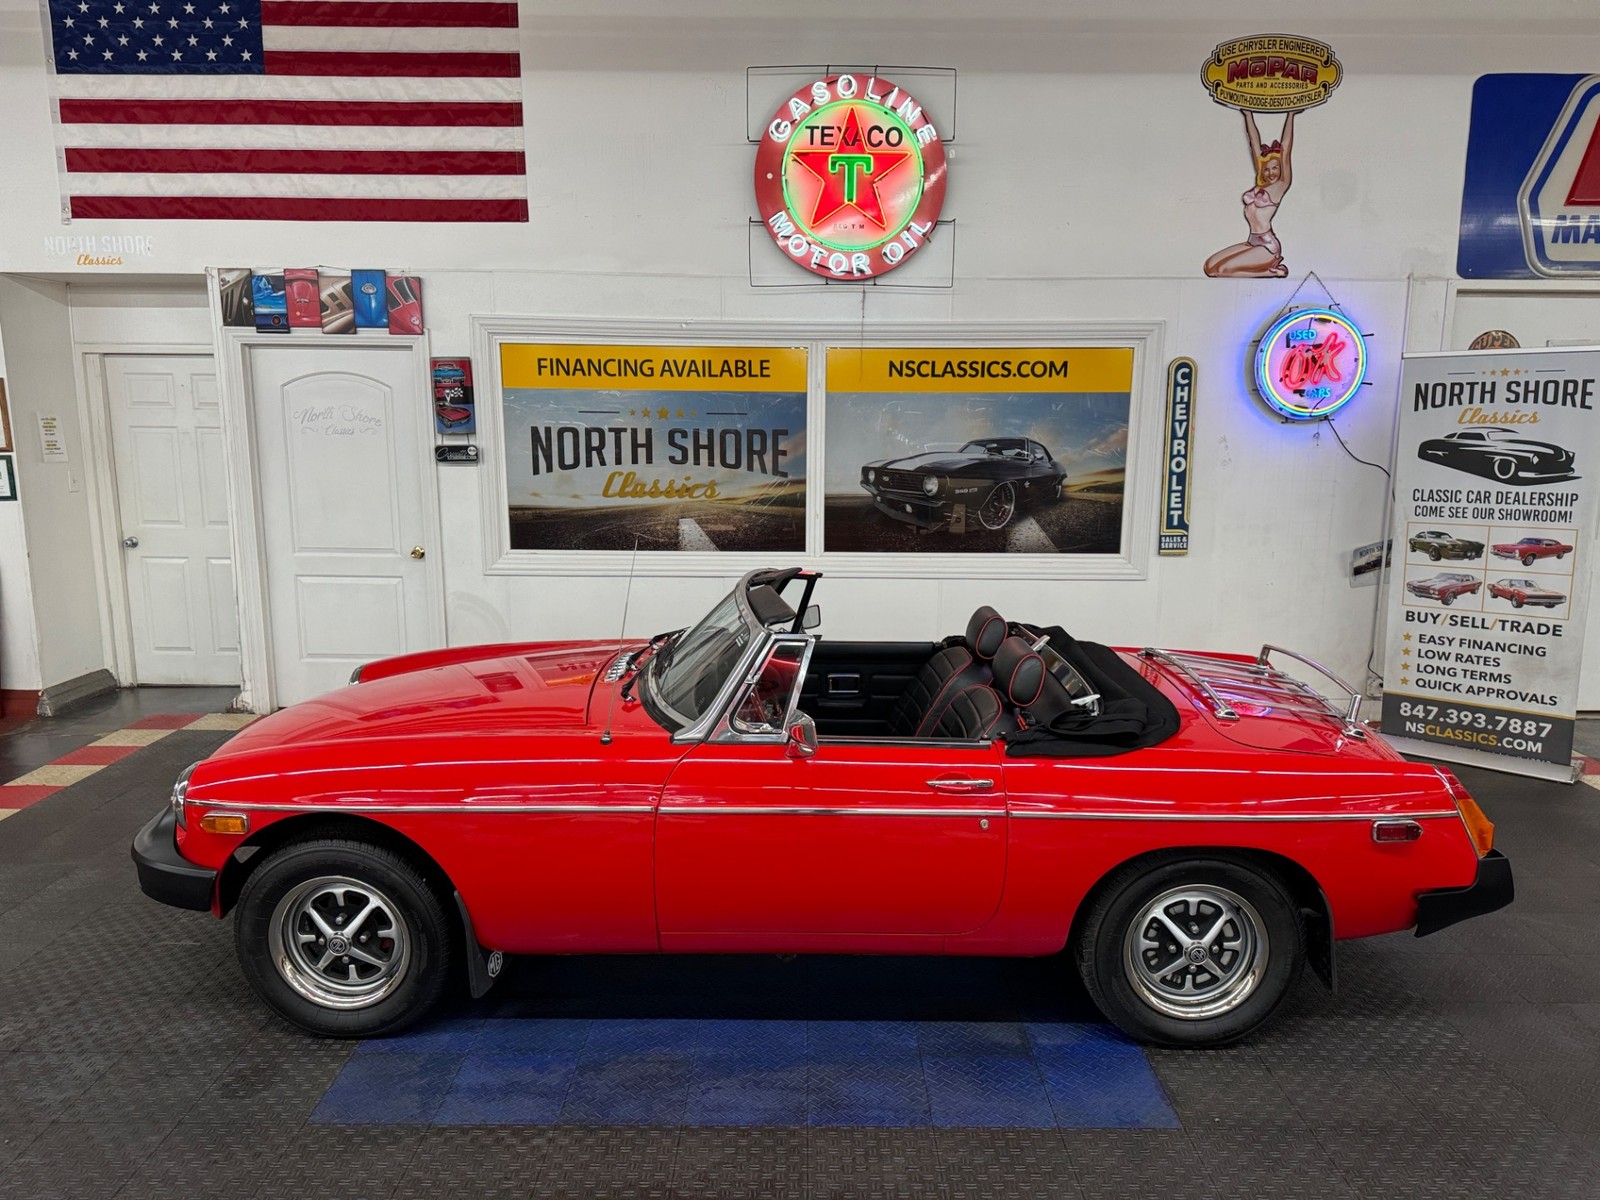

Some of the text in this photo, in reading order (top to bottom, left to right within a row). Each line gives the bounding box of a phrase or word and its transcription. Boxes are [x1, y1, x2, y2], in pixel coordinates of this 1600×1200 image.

[1221, 39, 1326, 58] USE CHRYSLER ENGINEERED
[1236, 81, 1254, 89] PARTS
[1270, 82, 1309, 90] ACCESSORIES
[769, 74, 938, 149] GASOLINE
[805, 125, 904, 148] TEXACO
[829, 154, 873, 204] T
[1551, 214, 1600, 244] MA
[44, 235, 155, 257] NORTH SHORE
[769, 210, 933, 276] MOTOR OIL
[76, 253, 123, 266] Classics
[1289, 329, 1317, 340] USED
[537, 357, 771, 379] FINANCING AVAILABLE
[888, 360, 1069, 379] NSCLASSICS.COM
[1282, 332, 1346, 391] OK
[1304, 387, 1331, 398] CARS
[1413, 378, 1595, 412] NORTH SHORE
[293, 404, 382, 427] North Shore
[1457, 407, 1541, 425] Classics
[530, 425, 789, 478] NORTH SHORE
[1170, 367, 1190, 526] CHEVROLET
[602, 470, 721, 499] Classics
[1412, 488, 1579, 507] CLASSIC CAR DEALERSHIP
[1414, 505, 1573, 523] COME SEE OUR SHOWROOM!
[1405, 610, 1563, 637] BUY/SELL/TRADE
[1418, 633, 1547, 657] EASY FINANCING
[1417, 648, 1501, 667] LOW RATES
[1416, 663, 1512, 684] LONG TERMS
[1415, 678, 1558, 706] QUICK APPROVALS
[1400, 702, 1552, 738] 847.393.7887
[1405, 721, 1543, 753] NSCLASSICS.COM
